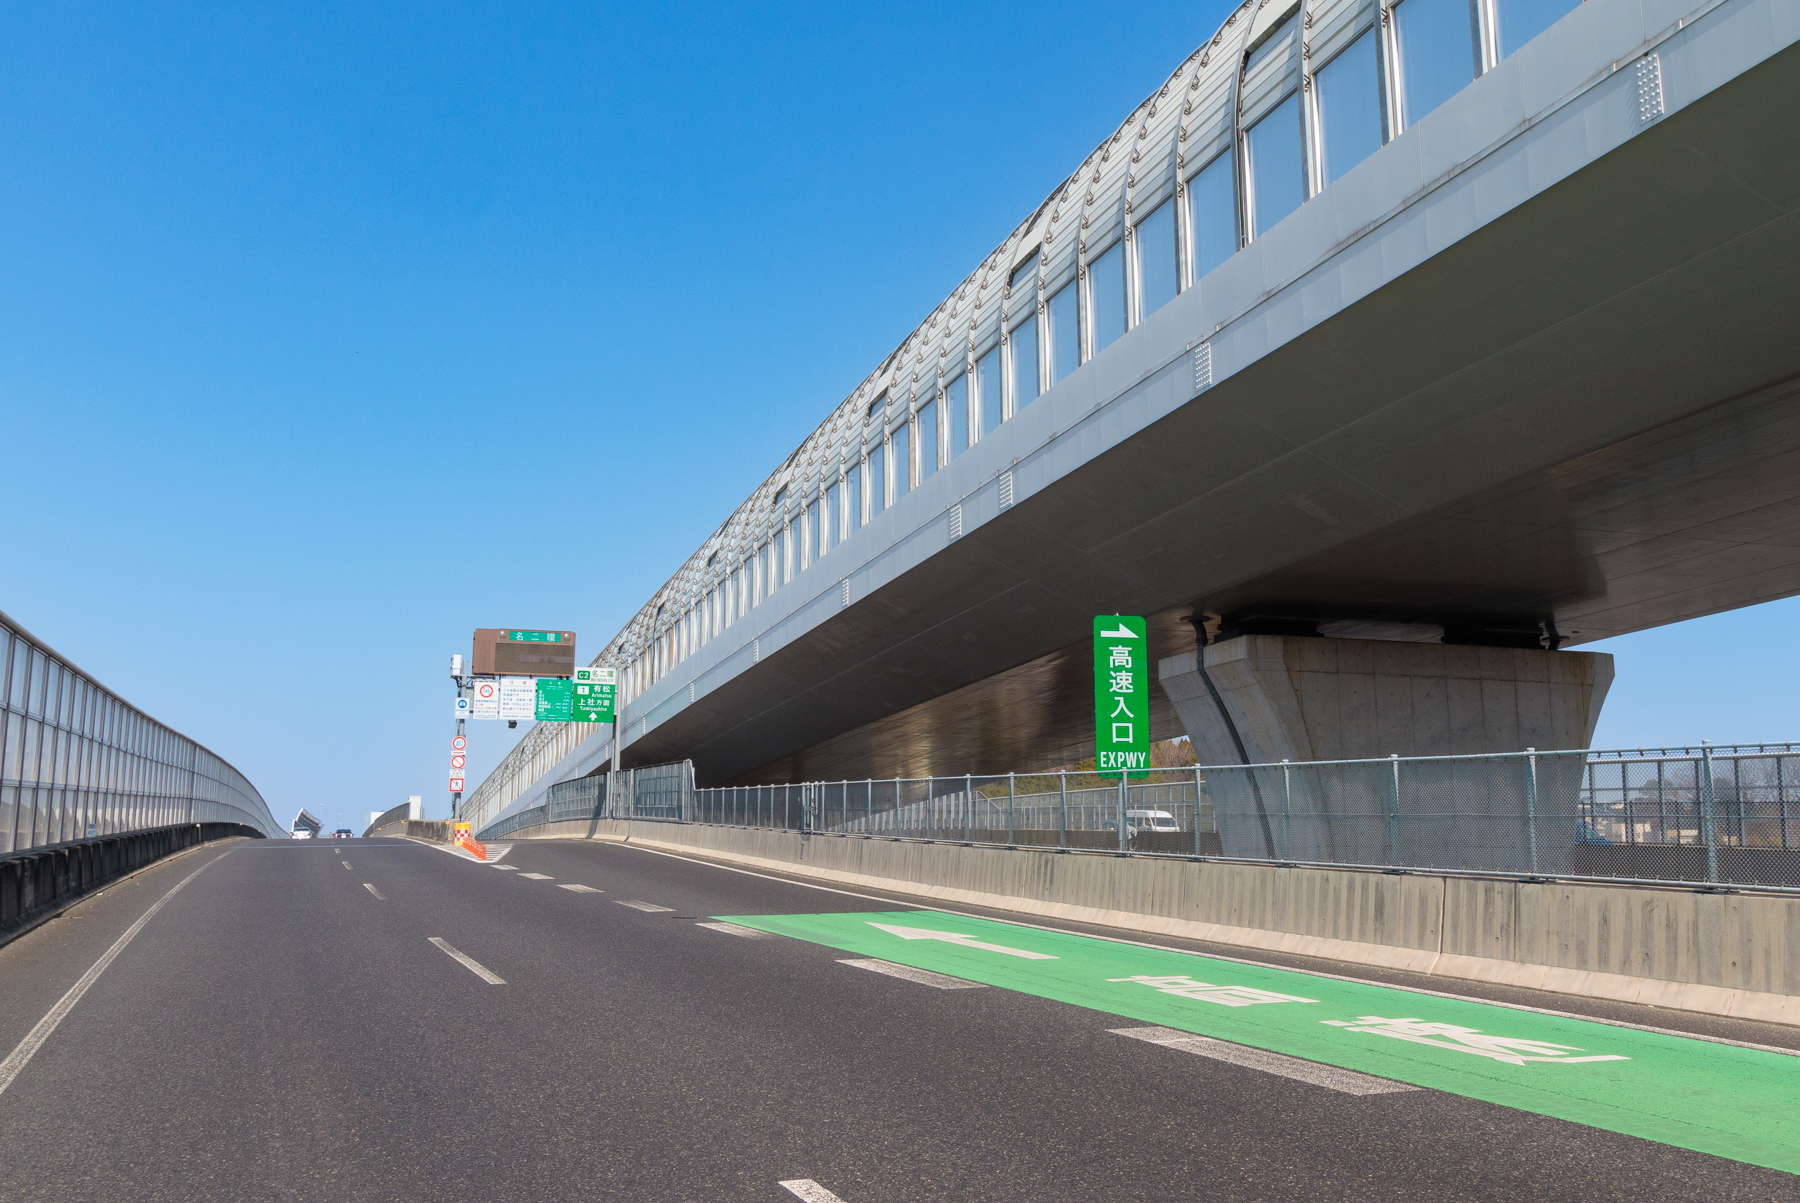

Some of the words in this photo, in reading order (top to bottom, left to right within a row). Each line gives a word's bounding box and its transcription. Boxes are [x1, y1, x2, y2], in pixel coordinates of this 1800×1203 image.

[516, 631, 556, 642] 名二環
[578, 671, 589, 679] C2
[593, 684, 611, 693] 有松
[1108, 645, 1135, 744] 高速入口
[577, 697, 610, 707] 上社方面
[1100, 751, 1146, 768] EXPWY
